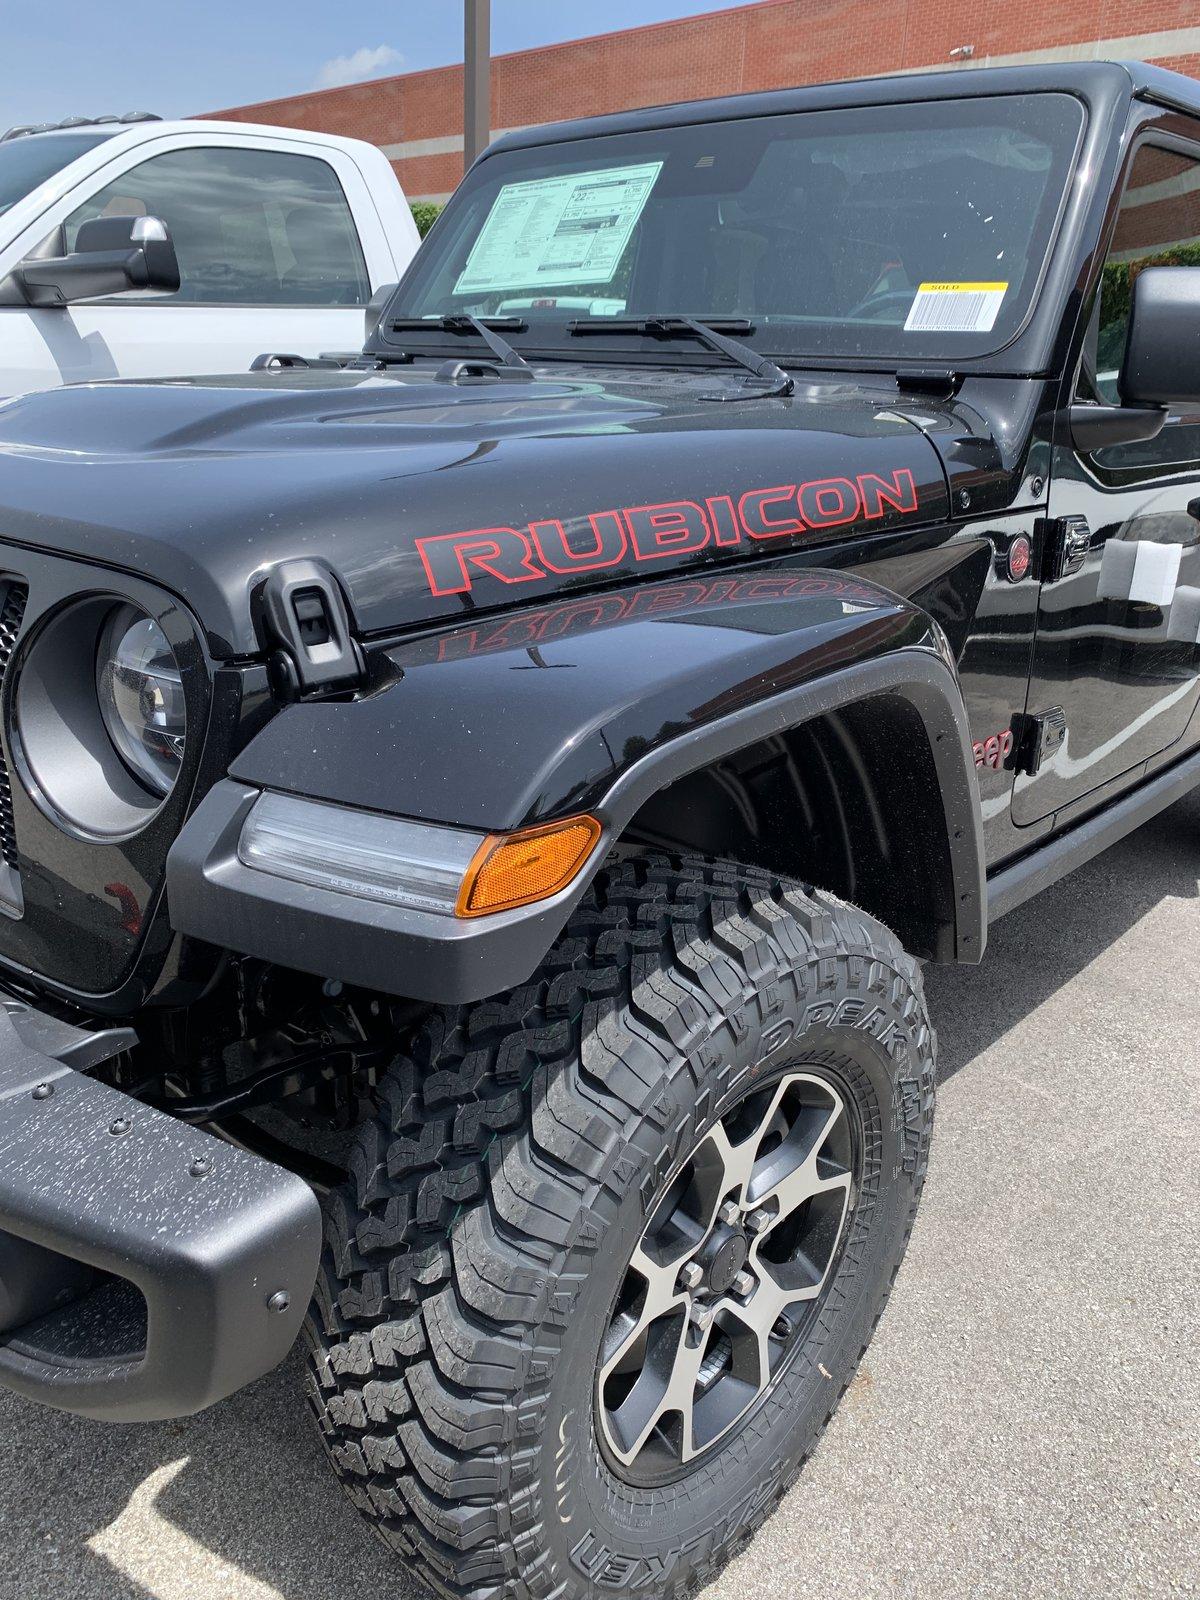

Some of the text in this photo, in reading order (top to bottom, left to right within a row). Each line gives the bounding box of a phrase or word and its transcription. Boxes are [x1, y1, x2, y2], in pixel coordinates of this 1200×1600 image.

[574, 192, 588, 202] 22
[415, 468, 919, 598] RUBICON
[972, 729, 1014, 770] eep
